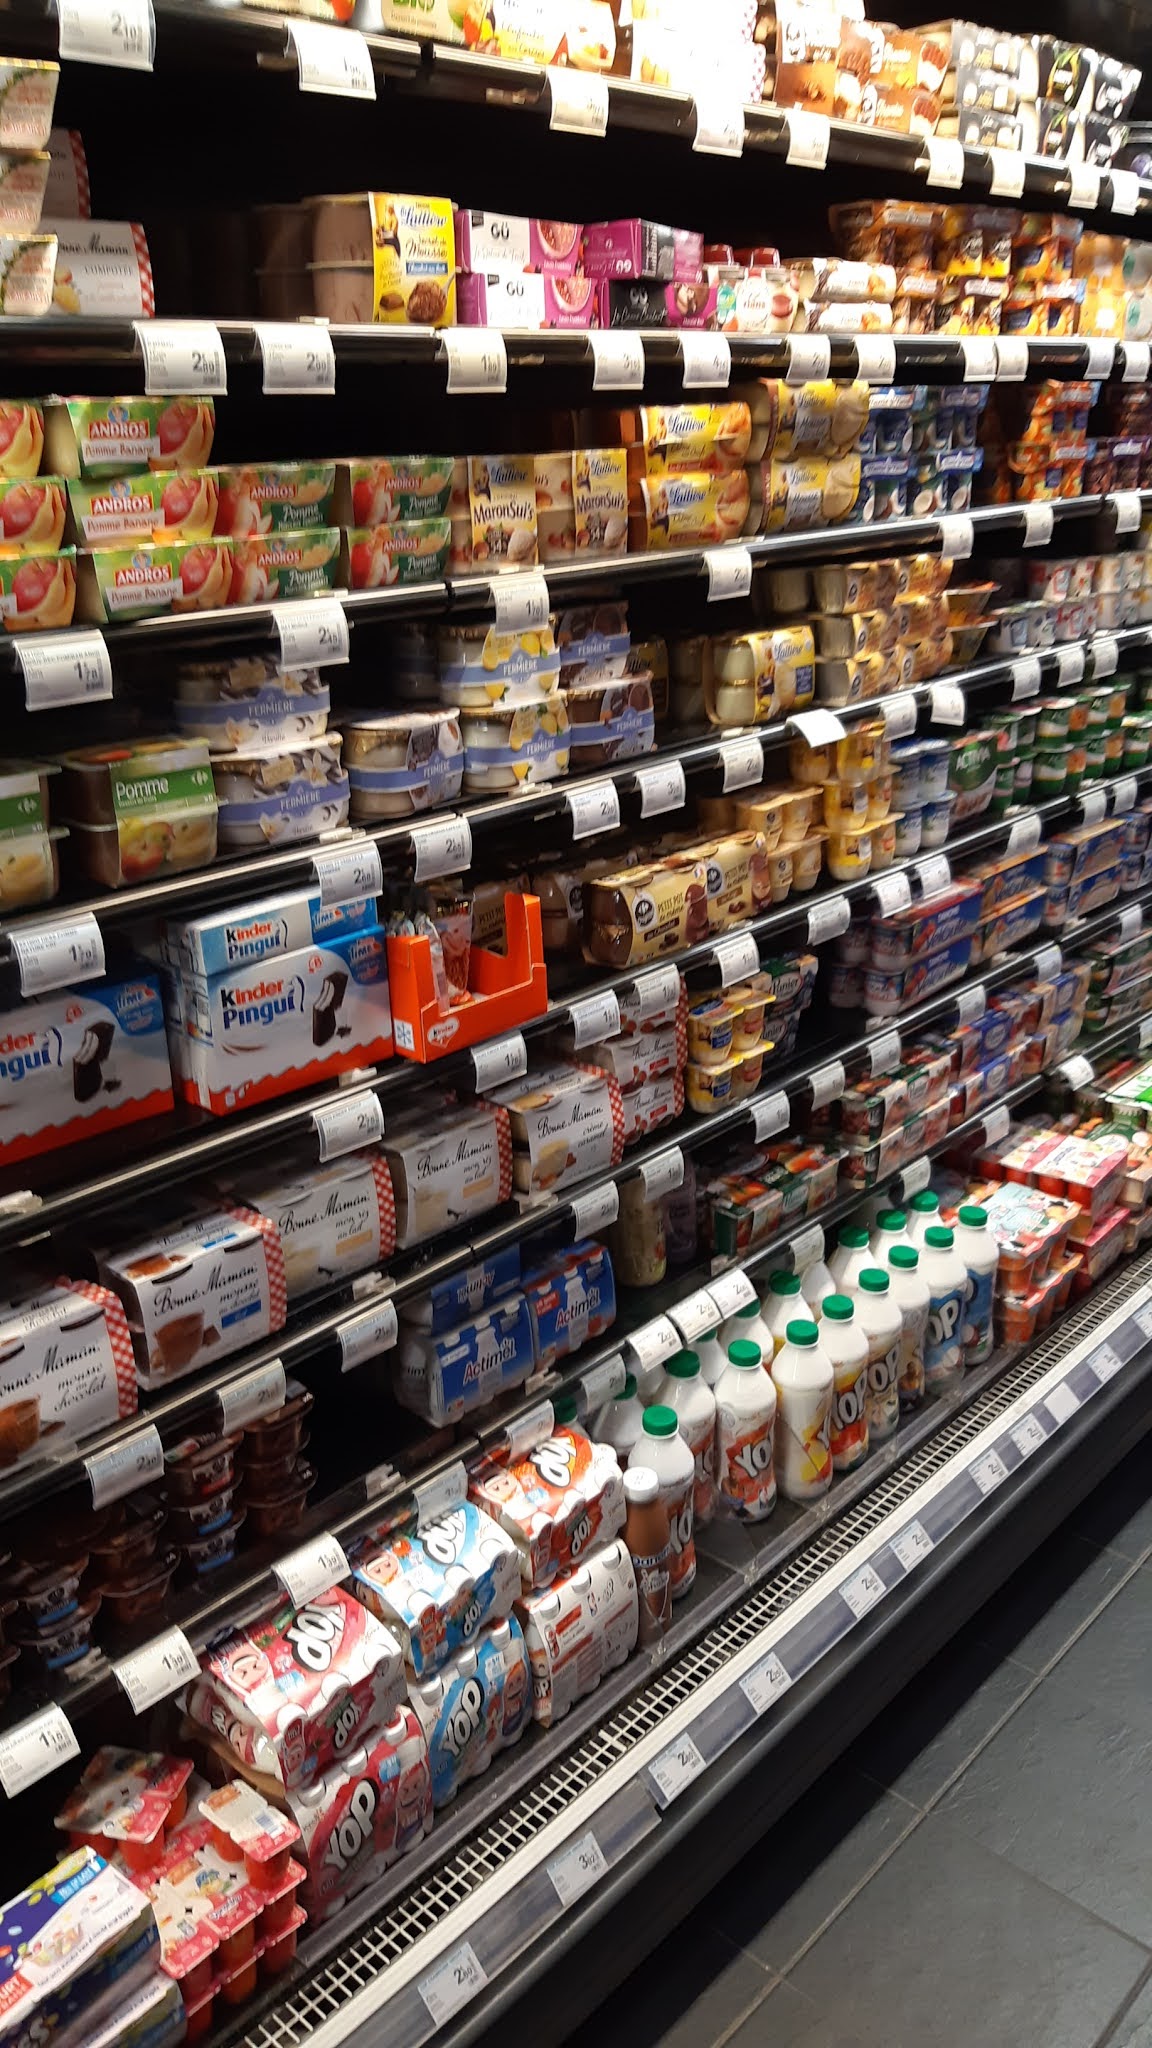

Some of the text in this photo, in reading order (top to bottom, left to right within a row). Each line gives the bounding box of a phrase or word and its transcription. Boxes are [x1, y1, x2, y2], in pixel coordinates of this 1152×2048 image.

[115, 777, 169, 801] Pomme
[537, 1102, 604, 1139] Bonne Maman
[418, 1138, 493, 1181] Bonne Maman
[279, 1190, 371, 1237] Bonne Maman
[153, 1261, 257, 1318] Bonne Maman
[556, 1292, 599, 1331] Actimel
[929, 1299, 959, 1345] OP
[41, 1343, 100, 1378] Maman
[463, 1345, 517, 1385] Actimel
[734, 1438, 772, 1479] YO
[286, 1602, 346, 1673] YOP
[441, 1679, 482, 1757] YOP
[323, 1779, 377, 1869] YOP
